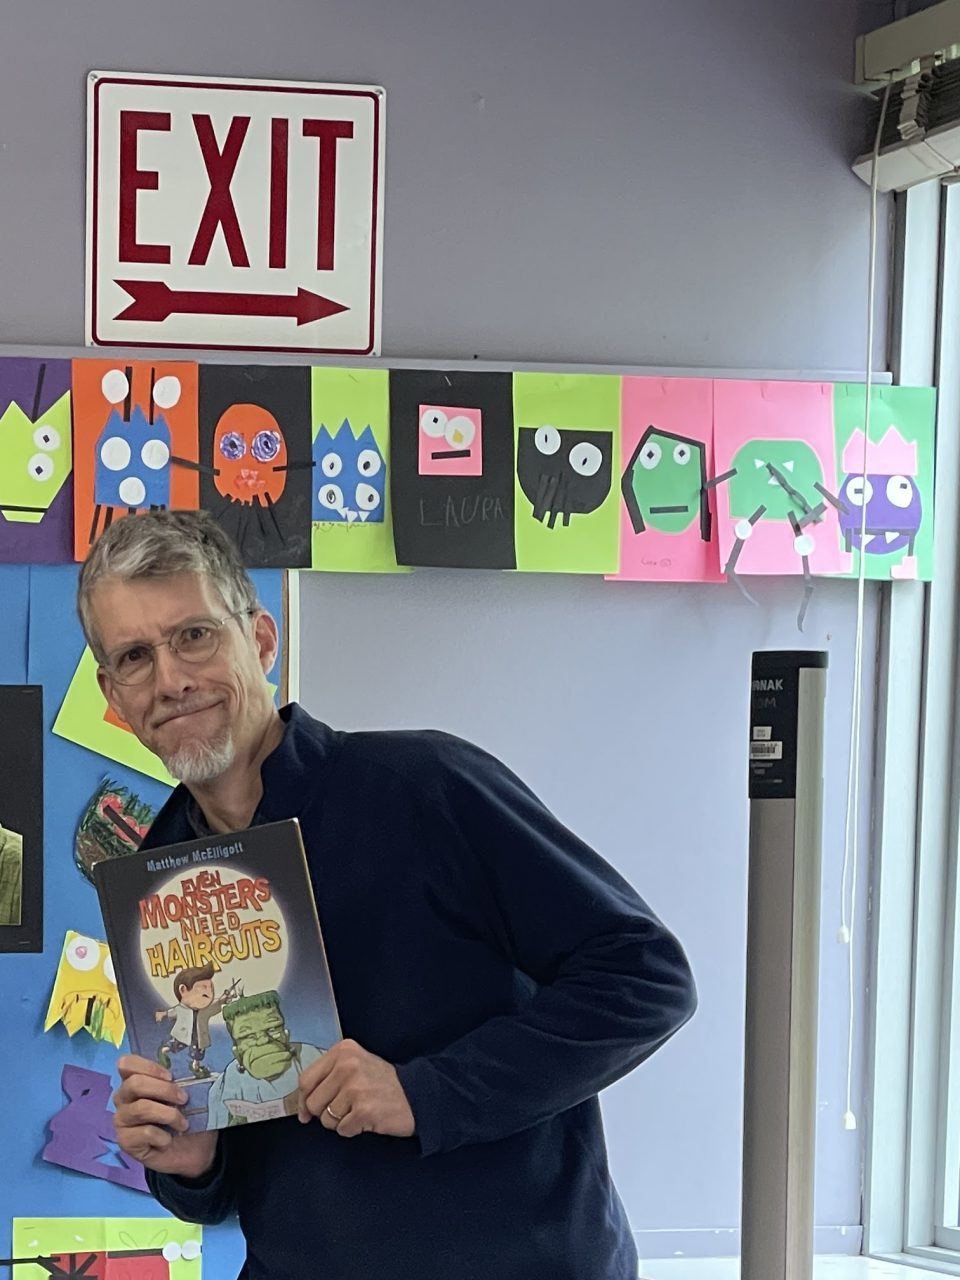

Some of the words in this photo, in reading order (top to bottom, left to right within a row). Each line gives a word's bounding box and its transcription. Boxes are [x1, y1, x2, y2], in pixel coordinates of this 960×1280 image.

[118, 109, 355, 272] EXIT
[146, 854, 189, 872] Matthew
[192, 841, 244, 863] McElligott
[138, 876, 272, 930] MONSTERS
[181, 870, 222, 896] EVEN
[180, 911, 241, 941] NEED
[145, 918, 282, 978] HAIRCUTS
